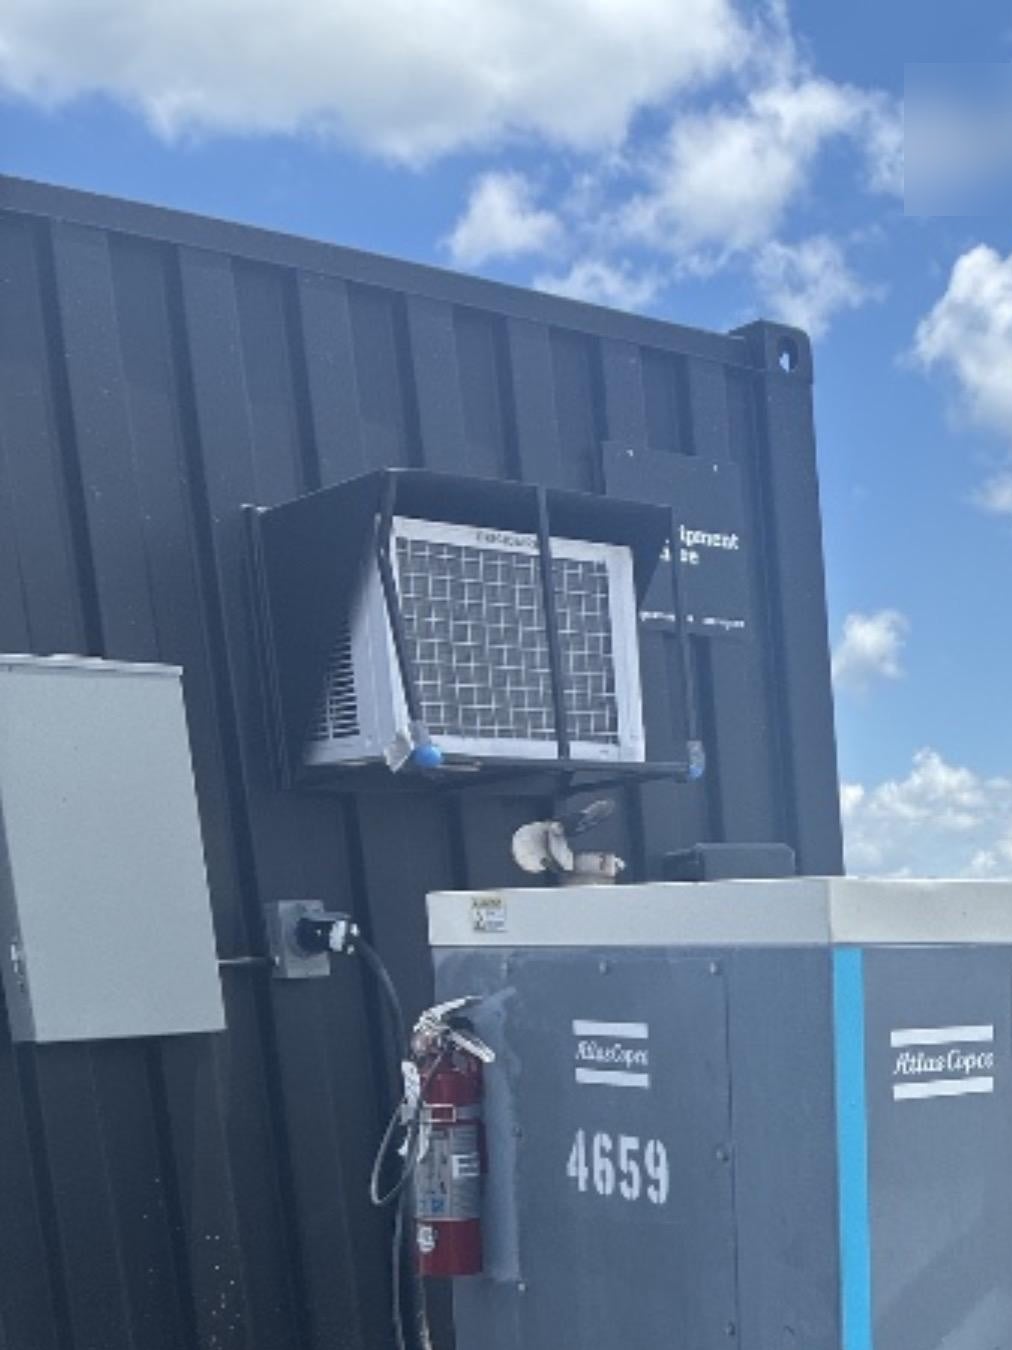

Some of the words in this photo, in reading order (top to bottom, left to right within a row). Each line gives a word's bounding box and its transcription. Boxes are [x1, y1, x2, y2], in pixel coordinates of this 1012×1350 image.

[893, 1051, 945, 1075] Atlas
[946, 1048, 994, 1075] Copco
[566, 1127, 670, 1205] 4659
